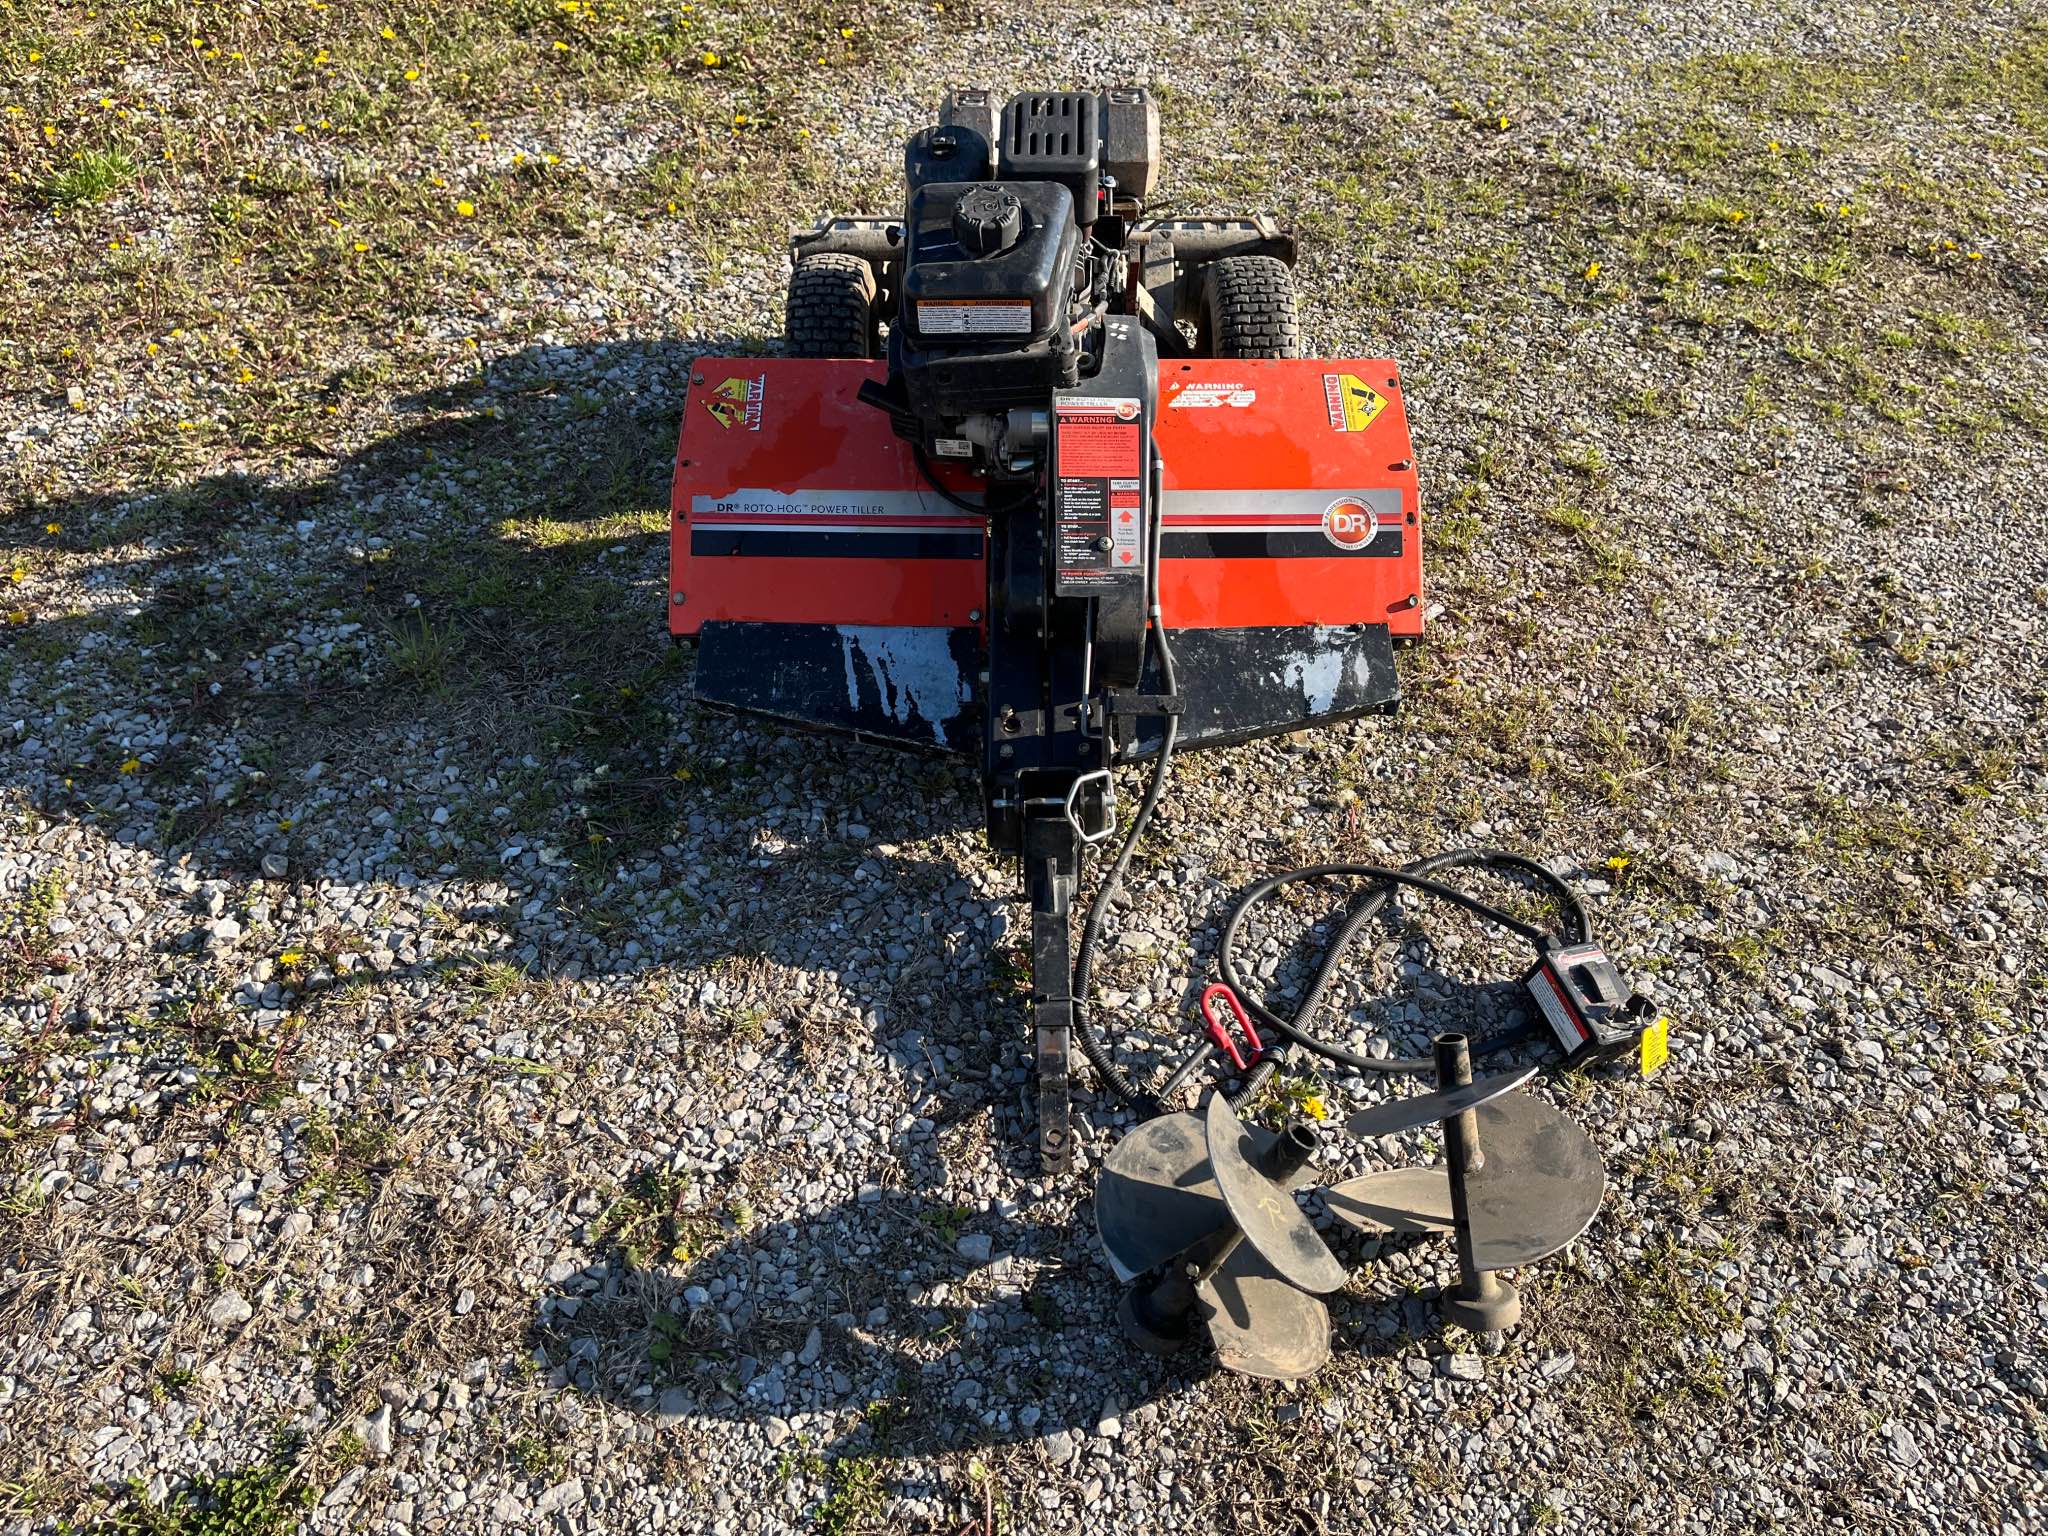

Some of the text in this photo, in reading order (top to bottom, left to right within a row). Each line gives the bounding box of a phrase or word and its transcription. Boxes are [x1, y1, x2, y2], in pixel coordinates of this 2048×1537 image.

[811, 504, 848, 514] POWER
[851, 505, 885, 514] TILLER
[1333, 513, 1367, 533] DR
